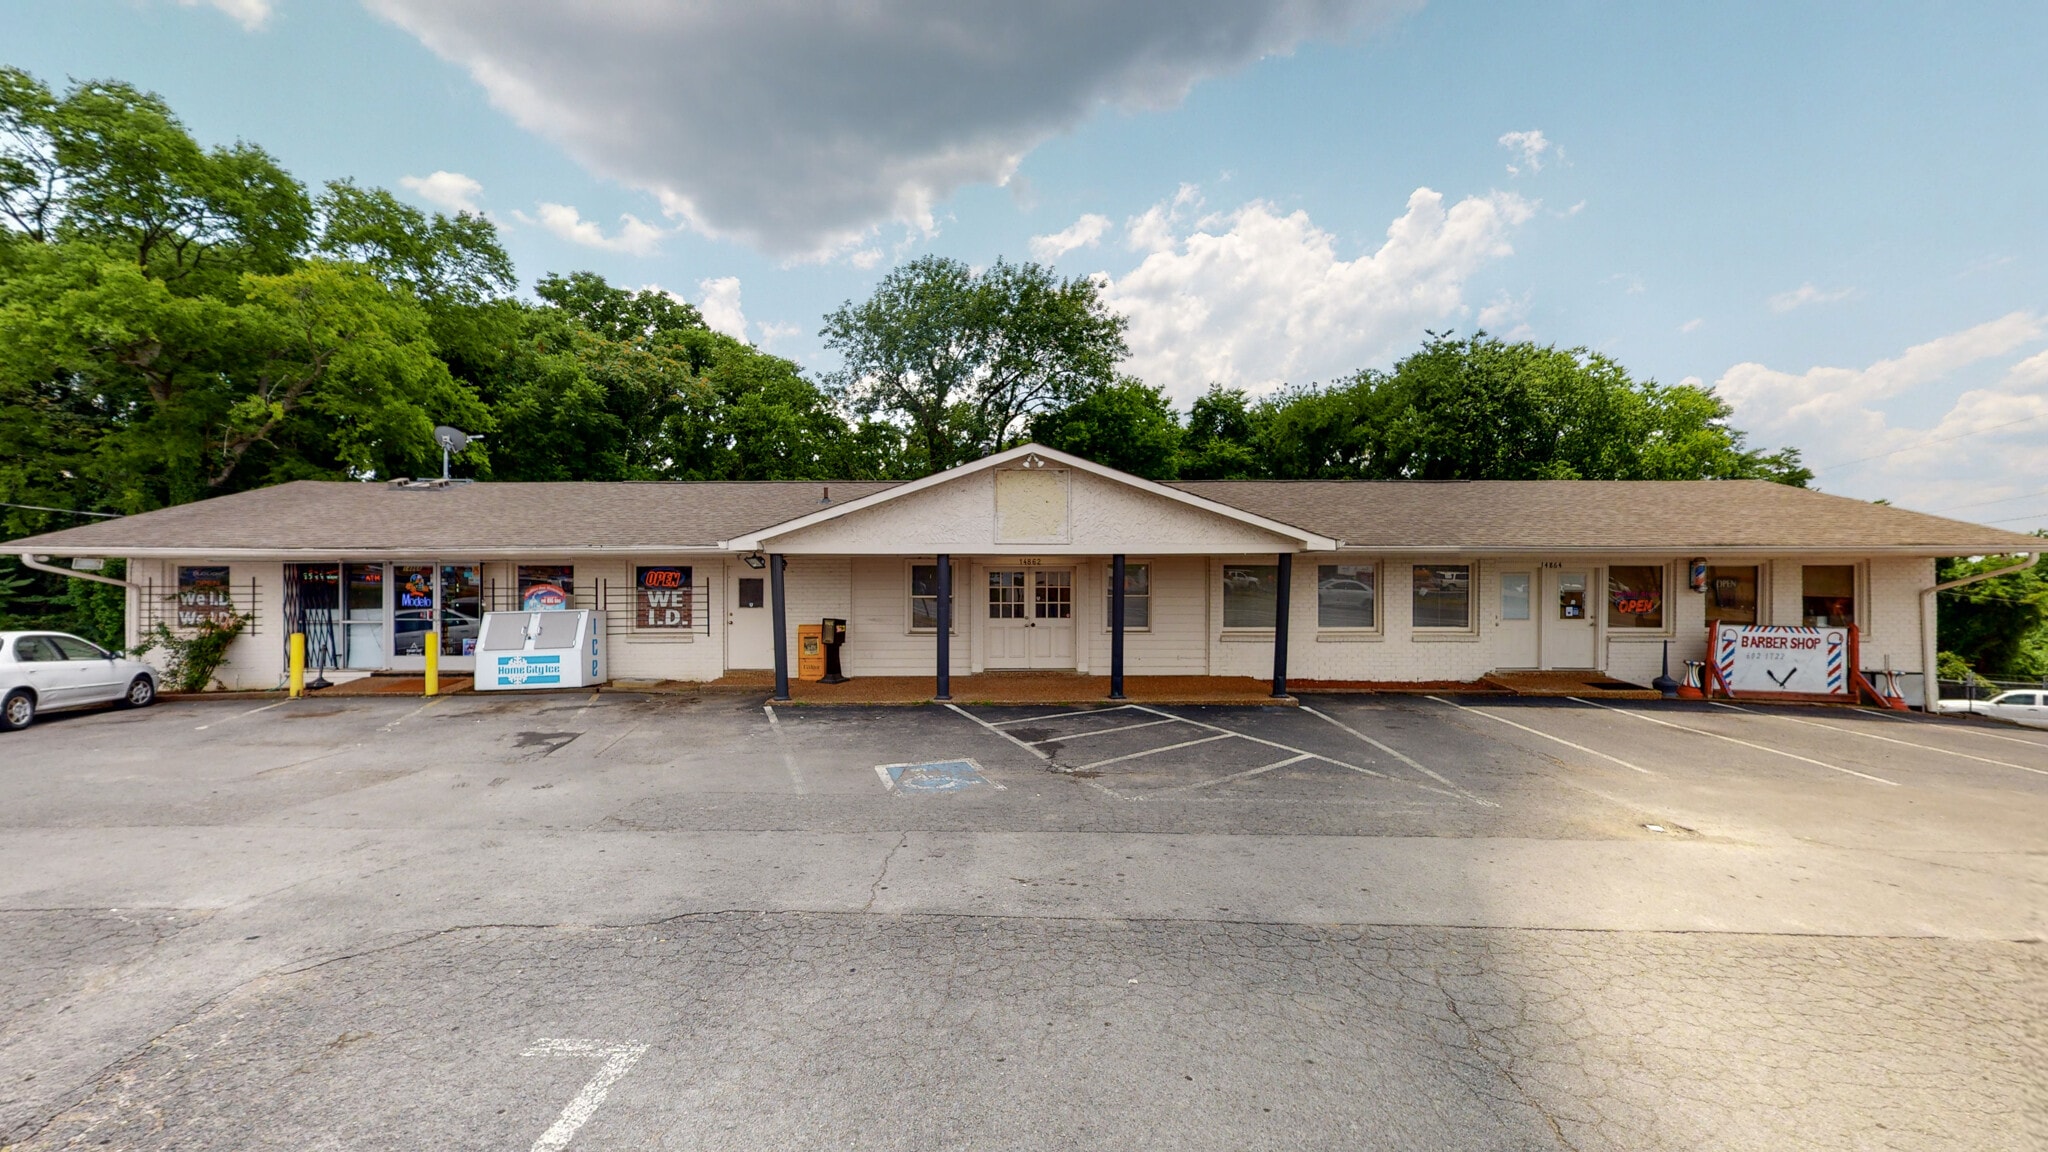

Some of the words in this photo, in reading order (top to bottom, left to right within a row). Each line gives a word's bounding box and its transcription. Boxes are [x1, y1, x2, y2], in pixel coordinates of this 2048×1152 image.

[645, 571, 680, 588] OPEN
[401, 593, 432, 607] Modelo
[647, 591, 683, 607] WE
[1618, 600, 1654, 613] OPEN
[648, 609, 689, 625] I.D.
[1741, 635, 1788, 649] BARBER
[1790, 637, 1821, 650] SHOP
[498, 666, 525, 675] Home
[526, 664, 544, 676] City
[545, 664, 560, 674] Ice
